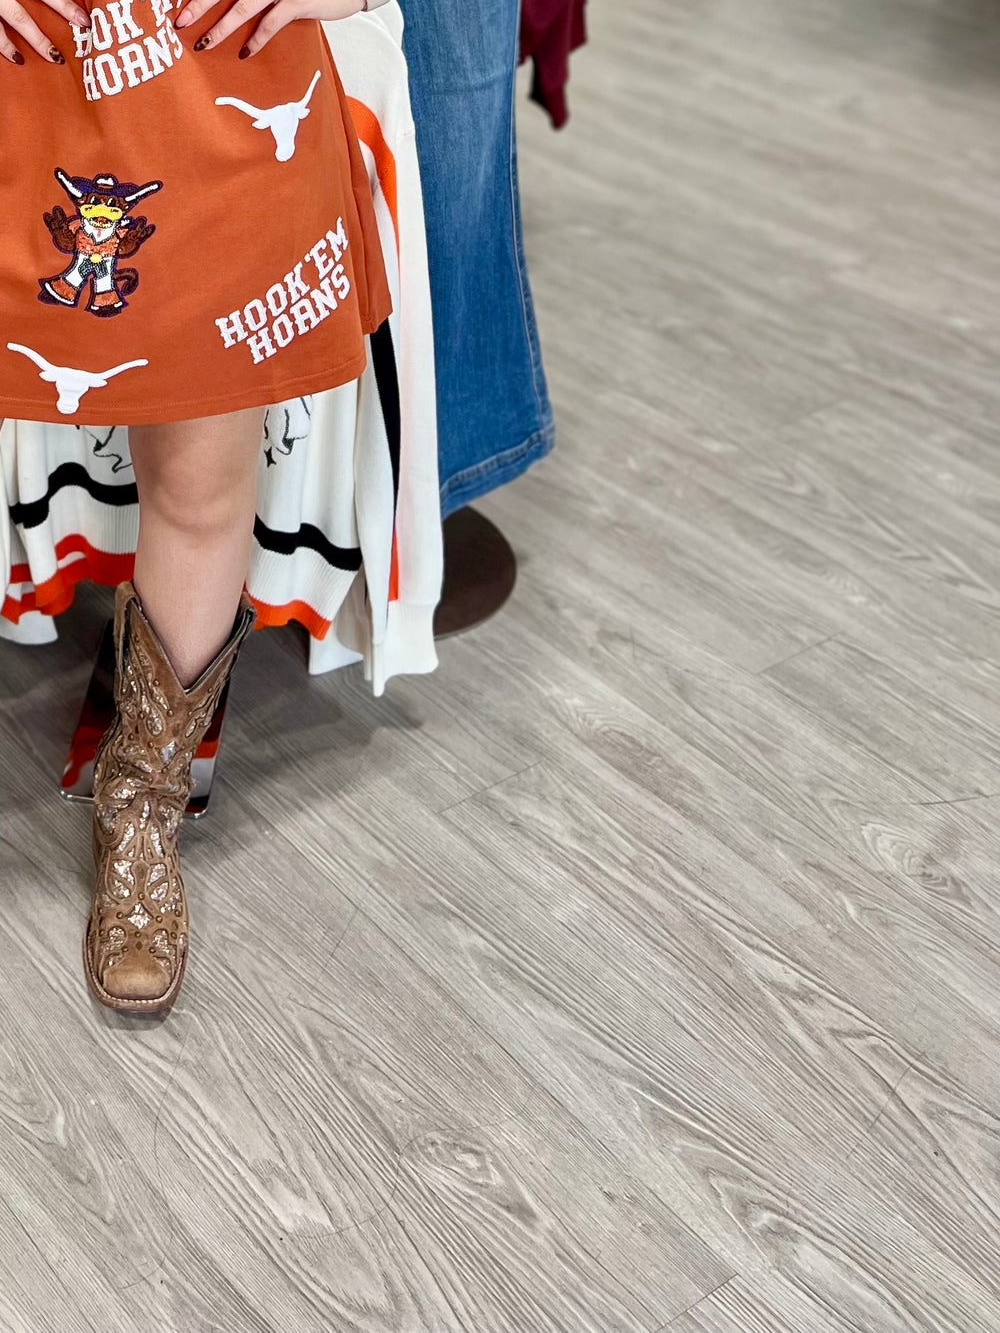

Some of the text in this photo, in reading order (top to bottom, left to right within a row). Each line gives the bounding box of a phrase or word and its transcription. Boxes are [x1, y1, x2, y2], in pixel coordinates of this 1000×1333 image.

[82, 17, 184, 101] HORNS
[214, 216, 349, 349] HOOK 'EM
[246, 264, 351, 364] HORNS
